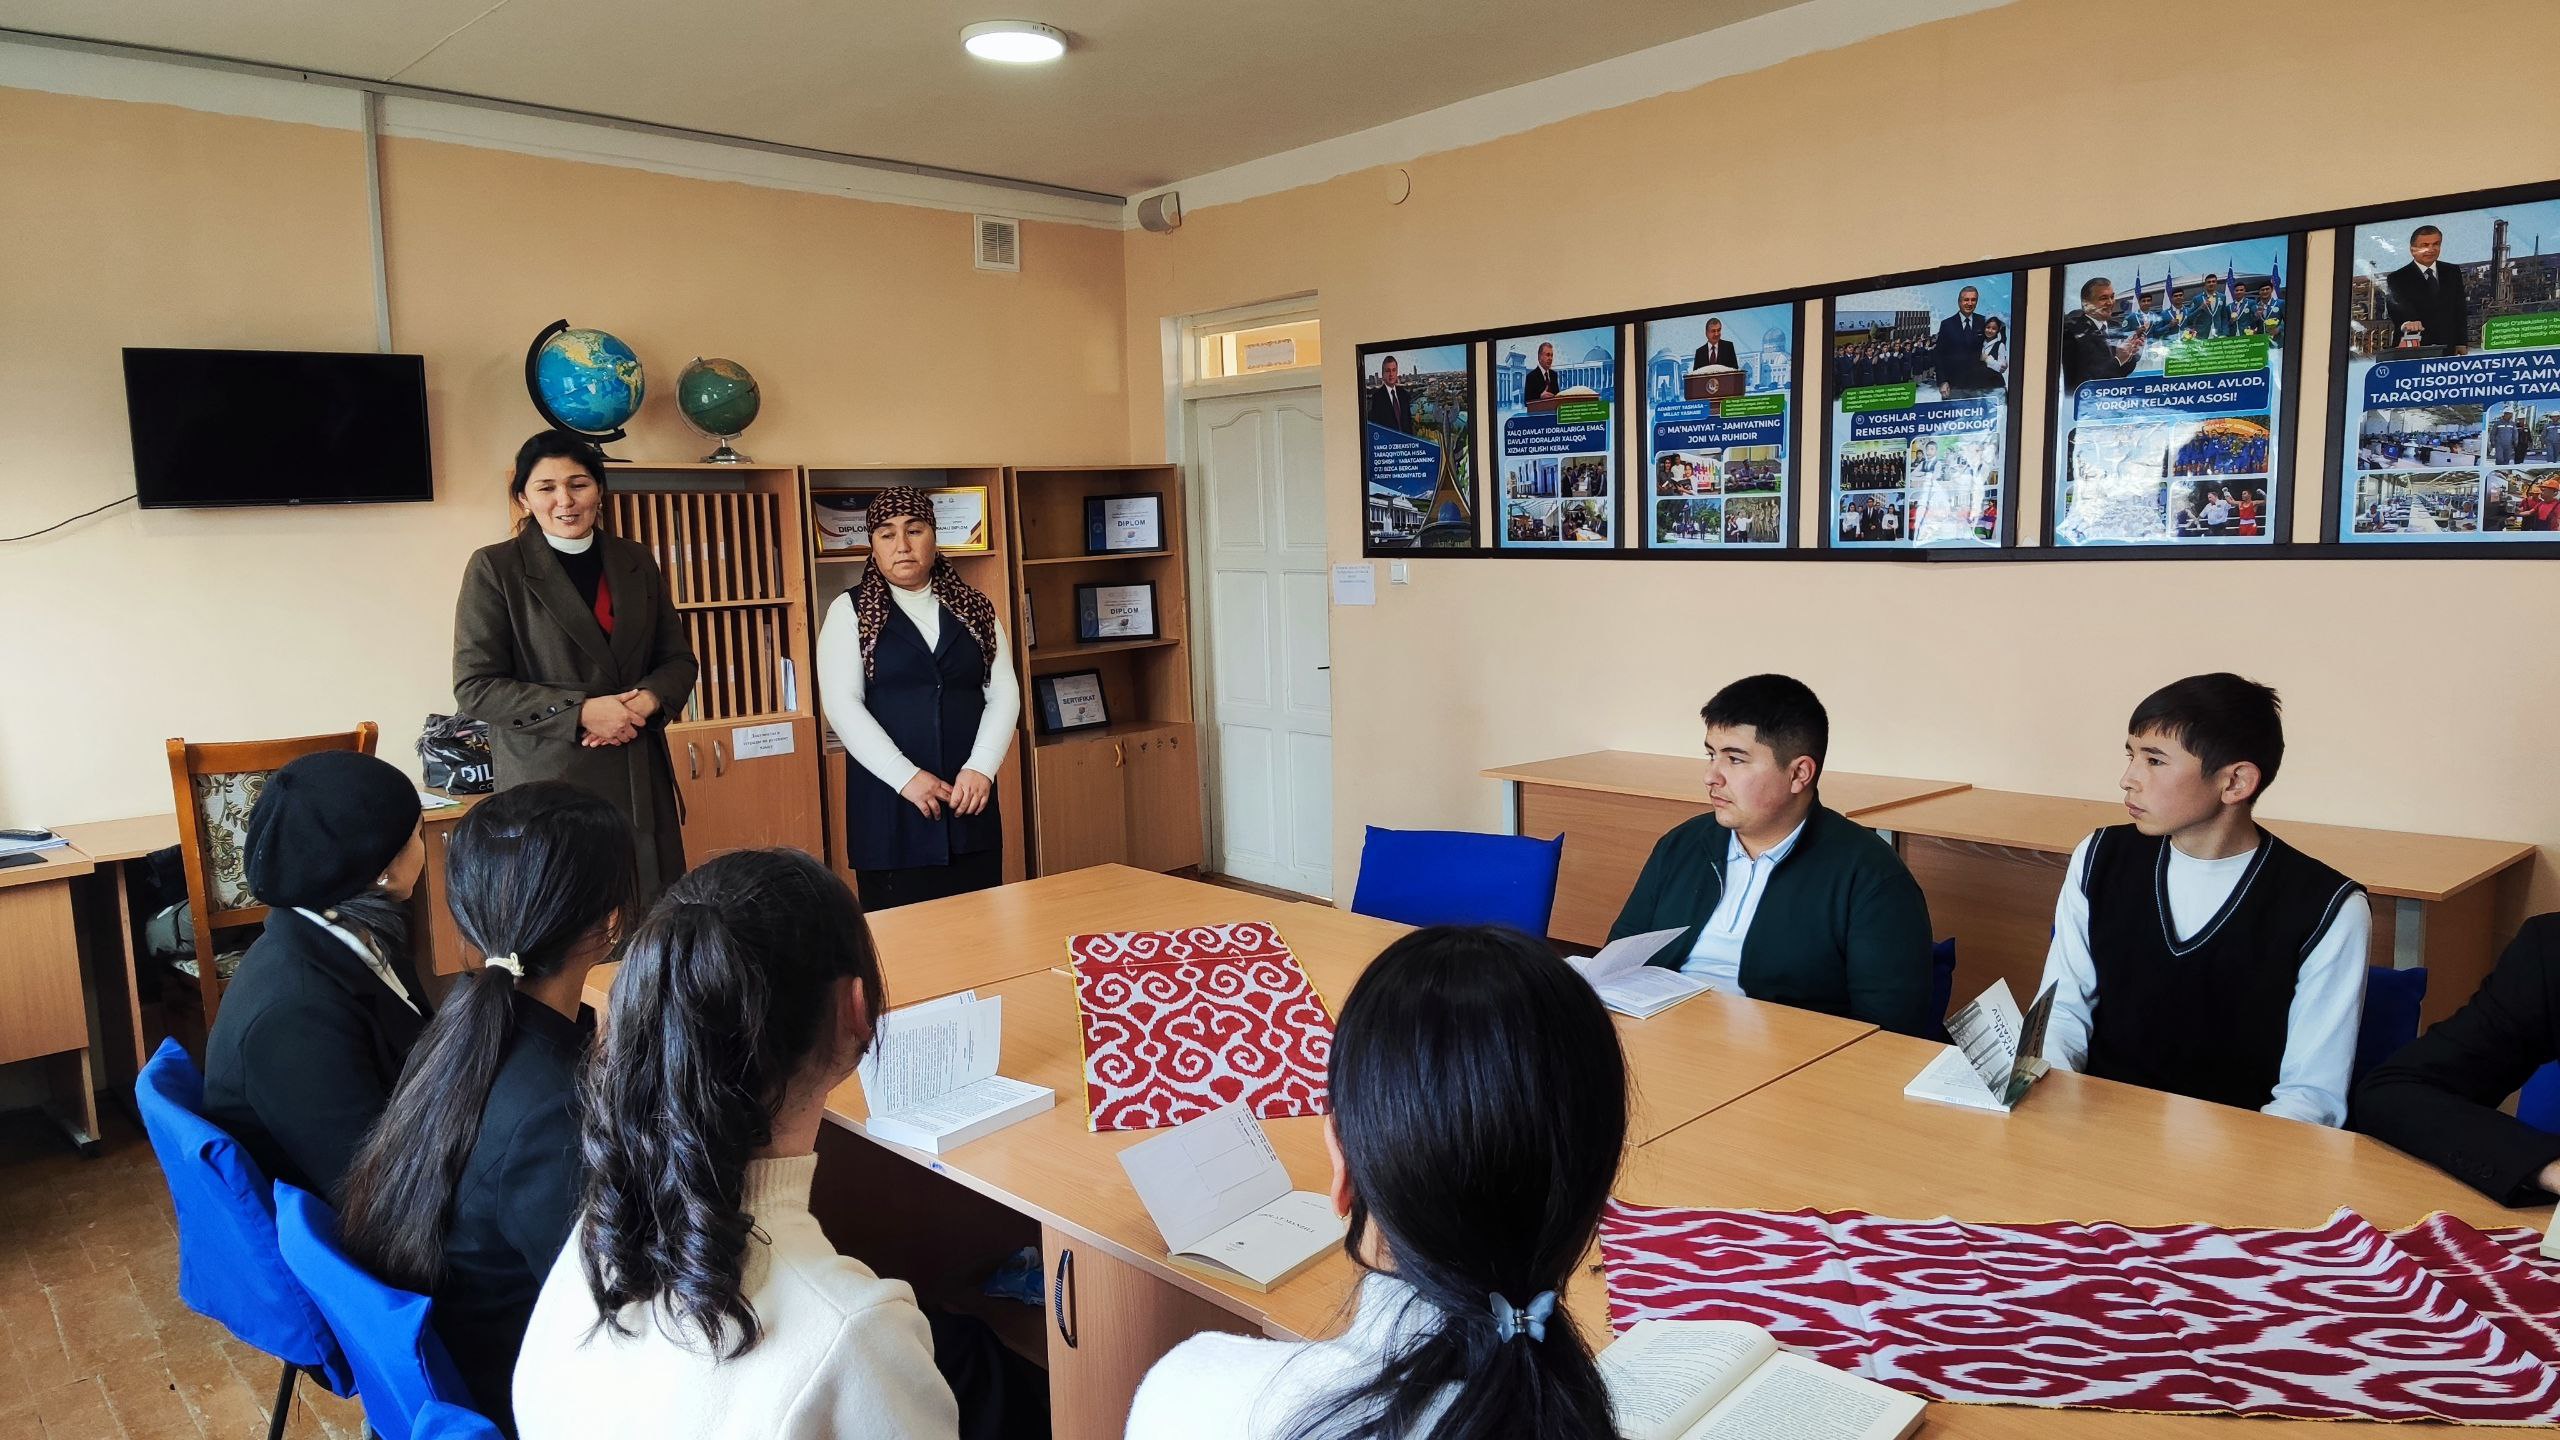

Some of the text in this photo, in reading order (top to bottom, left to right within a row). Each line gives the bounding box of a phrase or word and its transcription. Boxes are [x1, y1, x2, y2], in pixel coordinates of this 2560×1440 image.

[2421, 359, 2528, 374] INNOVATSIYA
[2532, 355, 2556, 366] VA
[2095, 385, 2135, 398] SPORT
[2145, 380, 2215, 395] BARKAMOL
[2217, 376, 2266, 389] AVLOD,
[2395, 371, 2496, 389] IQTISODIYOT
[2095, 392, 2238, 412] YORQIN KELAJAK ASOSI!
[2371, 385, 2515, 404] TARAQQIYOTINING
[1868, 412, 1917, 424] YOSHLAR
[1927, 407, 1984, 420] UCHINCHI
[1522, 428, 1545, 436] DAVLAT
[1545, 425, 1586, 434] IDORALARIGA
[1586, 424, 1605, 432] EMAS,
[1667, 423, 1716, 434] MA'NAVIYAT
[1722, 419, 1780, 431] JAMIYATNING
[1855, 419, 1995, 437] RENESSANS BUNYODKORI
[1507, 437, 1529, 445] DAVLAT
[1529, 436, 1561, 444] IDORALARI
[1722, 432, 1758, 441] RUHIDIR
[1117, 519, 1146, 527] DIPLOM
[1110, 607, 1139, 615] DIPLOM
[1062, 694, 1096, 705] SERTIFIKAT
[1993, 1020, 2015, 1058] MIXAIL
